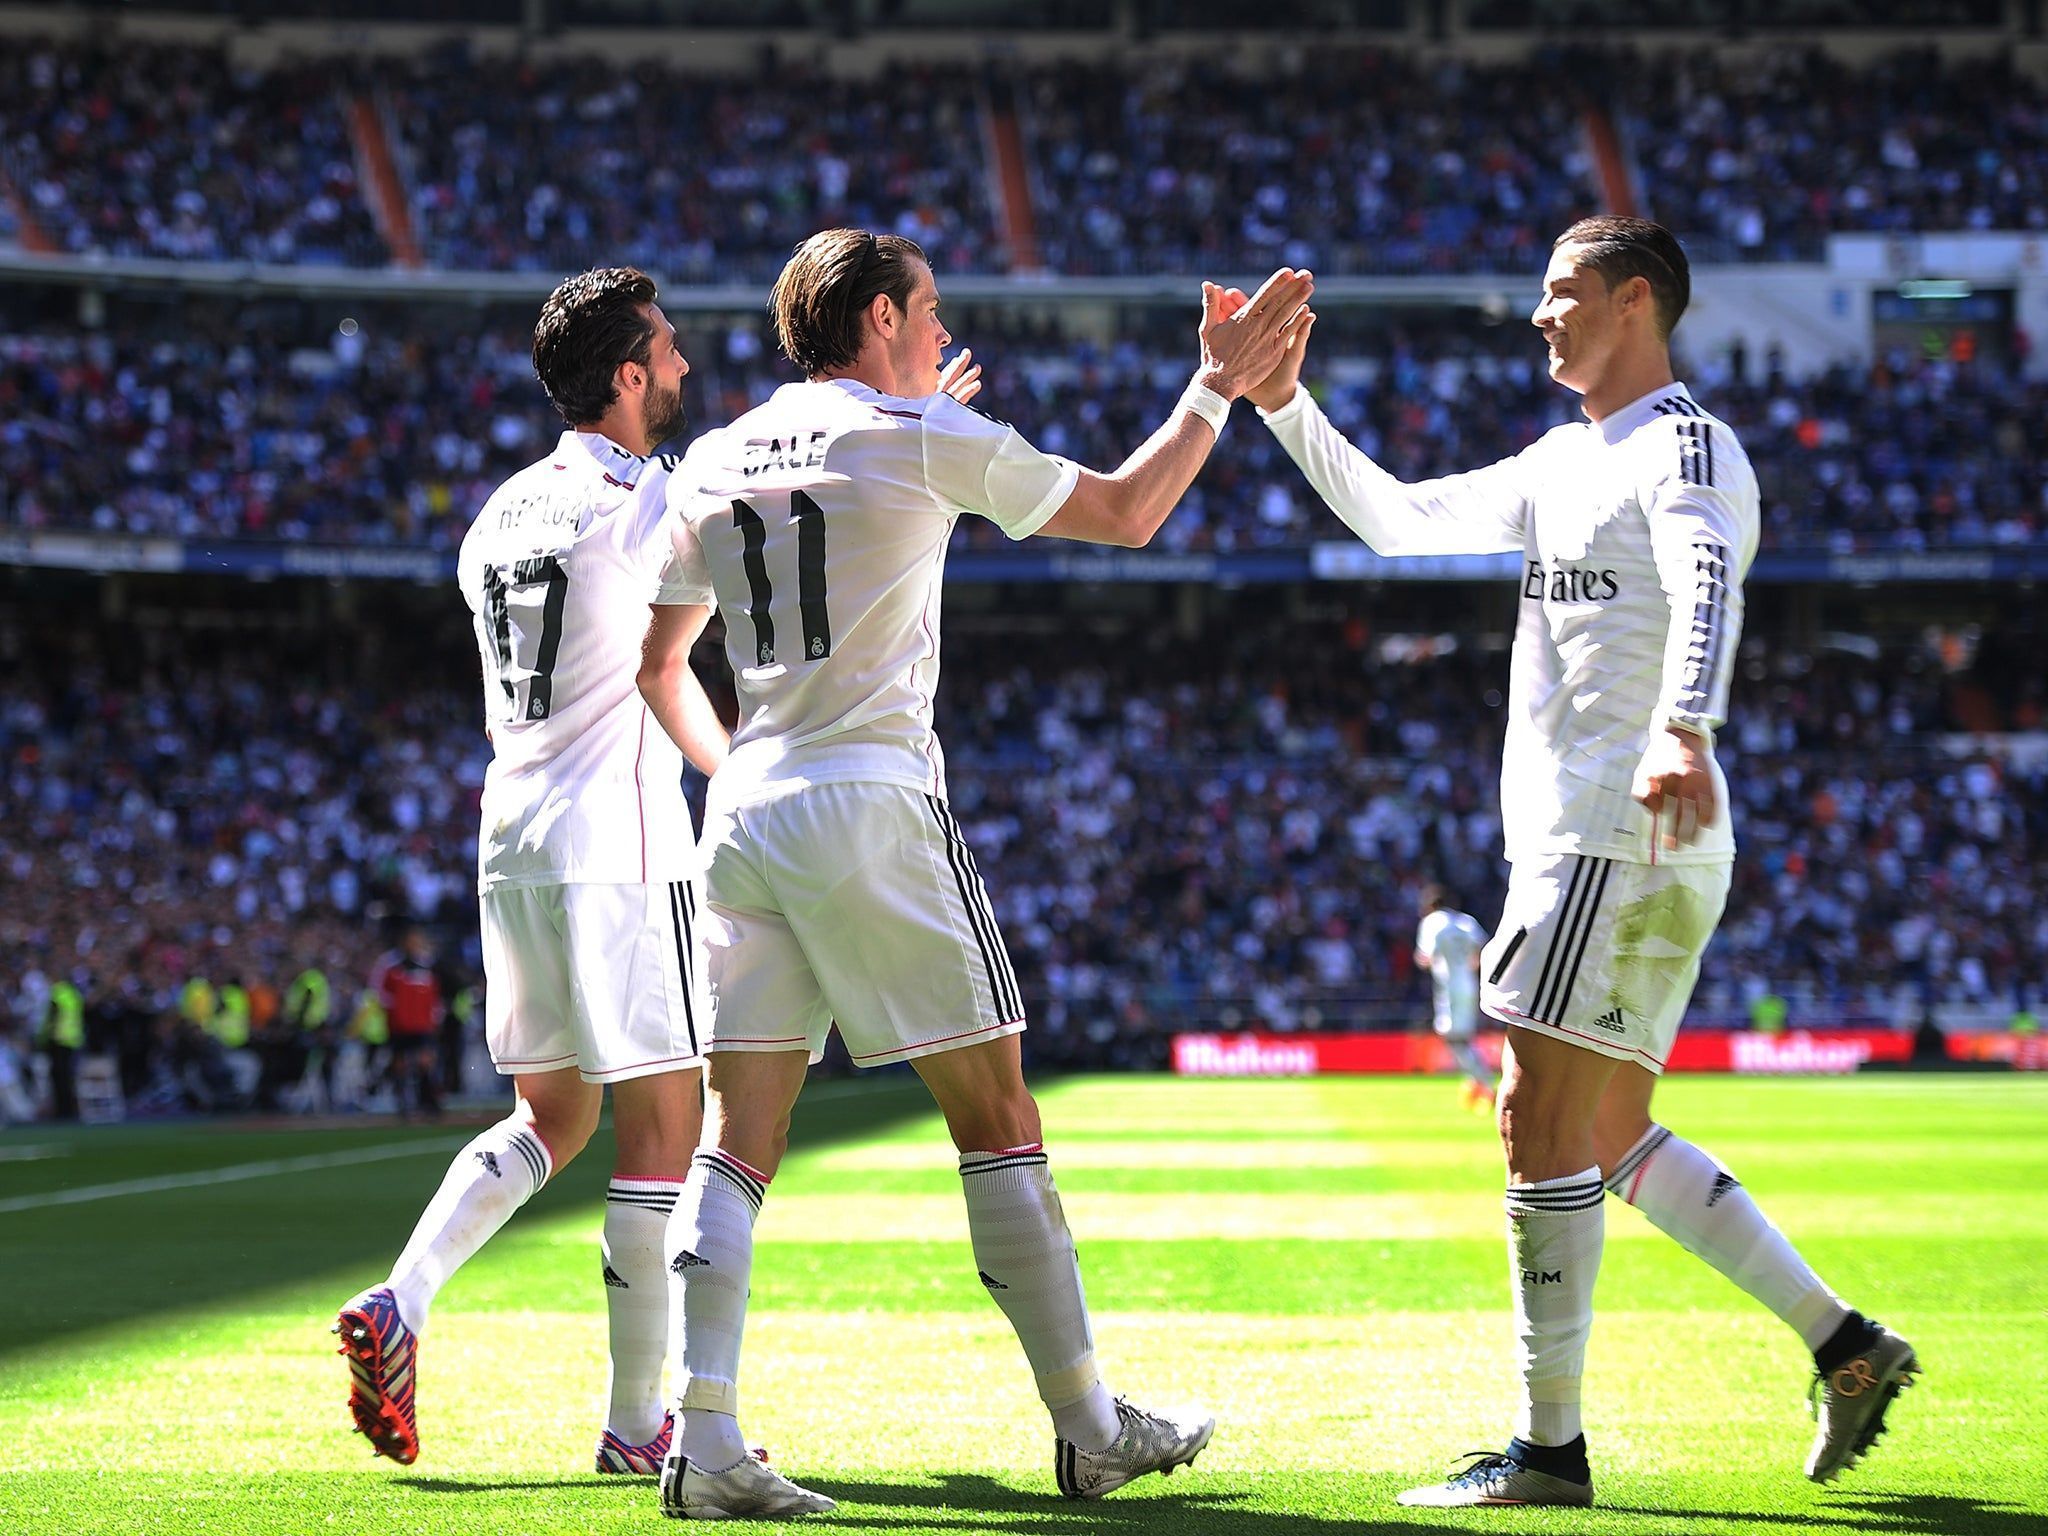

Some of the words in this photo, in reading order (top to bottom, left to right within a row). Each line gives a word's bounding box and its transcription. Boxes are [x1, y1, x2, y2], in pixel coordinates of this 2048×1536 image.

[730, 488, 832, 667] 11
[1524, 556, 1619, 603] Eates
[483, 554, 569, 722] 17
[1522, 1269, 1563, 1285] RM
